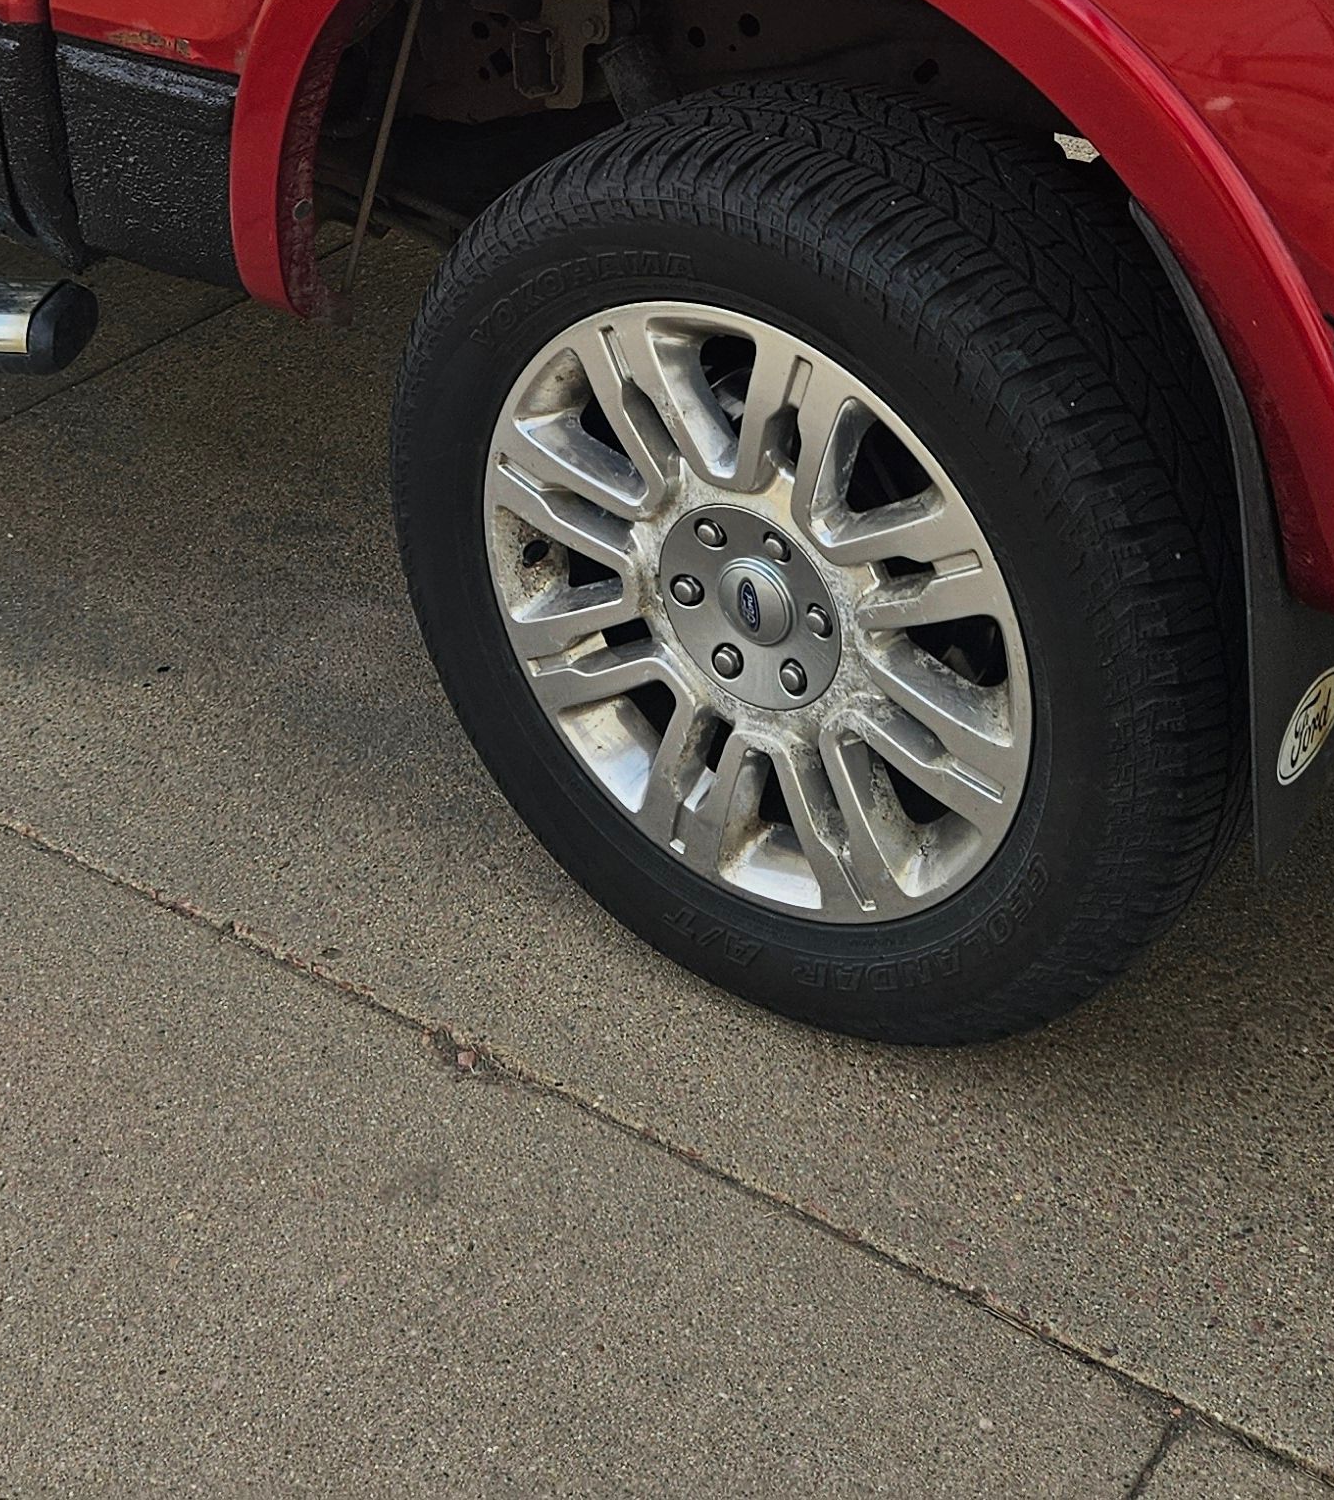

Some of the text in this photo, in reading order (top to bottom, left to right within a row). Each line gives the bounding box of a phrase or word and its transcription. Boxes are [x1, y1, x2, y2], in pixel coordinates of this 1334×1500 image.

[469, 251, 697, 346] YOKOHAMA
[1290, 687, 1332, 768] Ford
[663, 906, 767, 968] A/T
